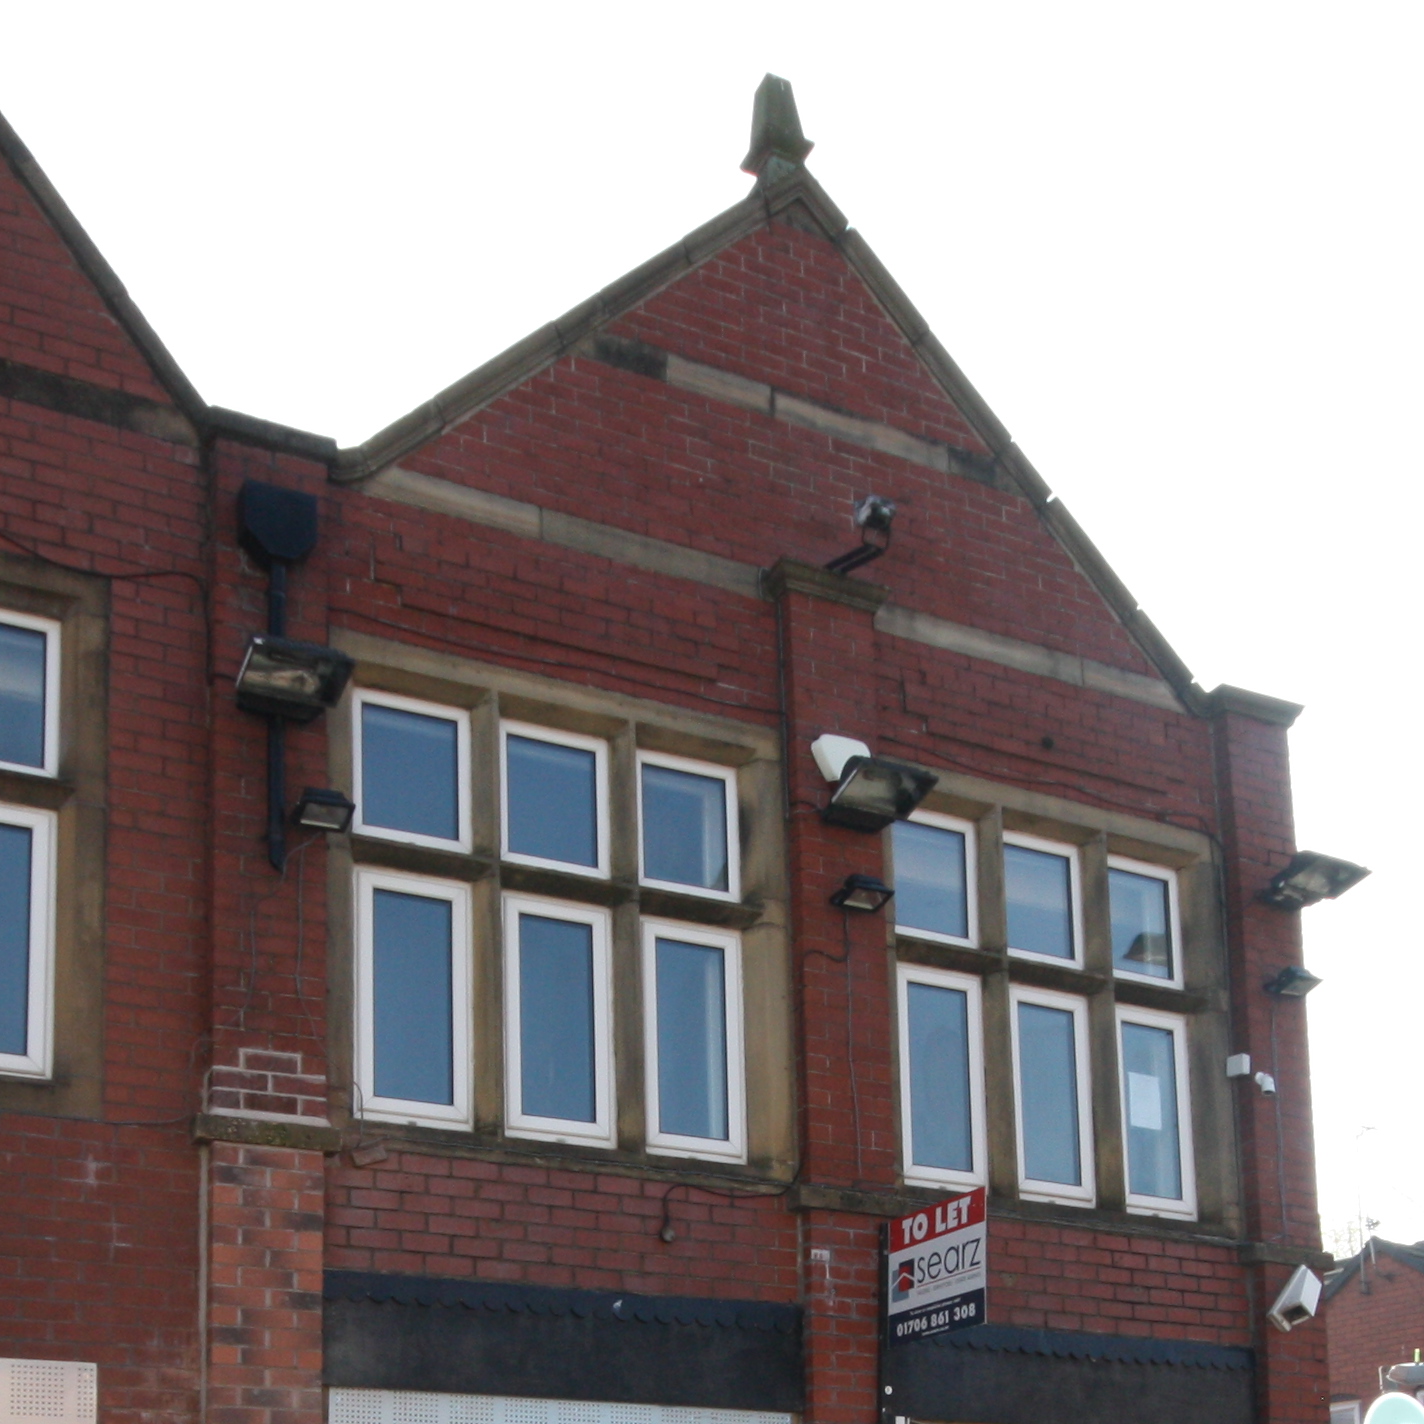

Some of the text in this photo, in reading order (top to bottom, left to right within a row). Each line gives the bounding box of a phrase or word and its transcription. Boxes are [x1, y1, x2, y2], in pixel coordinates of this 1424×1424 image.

[902, 1195, 972, 1245] TO LET
[917, 1238, 982, 1284] searz
[896, 1317, 928, 1338] 01706
[930, 1310, 950, 1328] 861
[953, 1302, 976, 1321] 308
